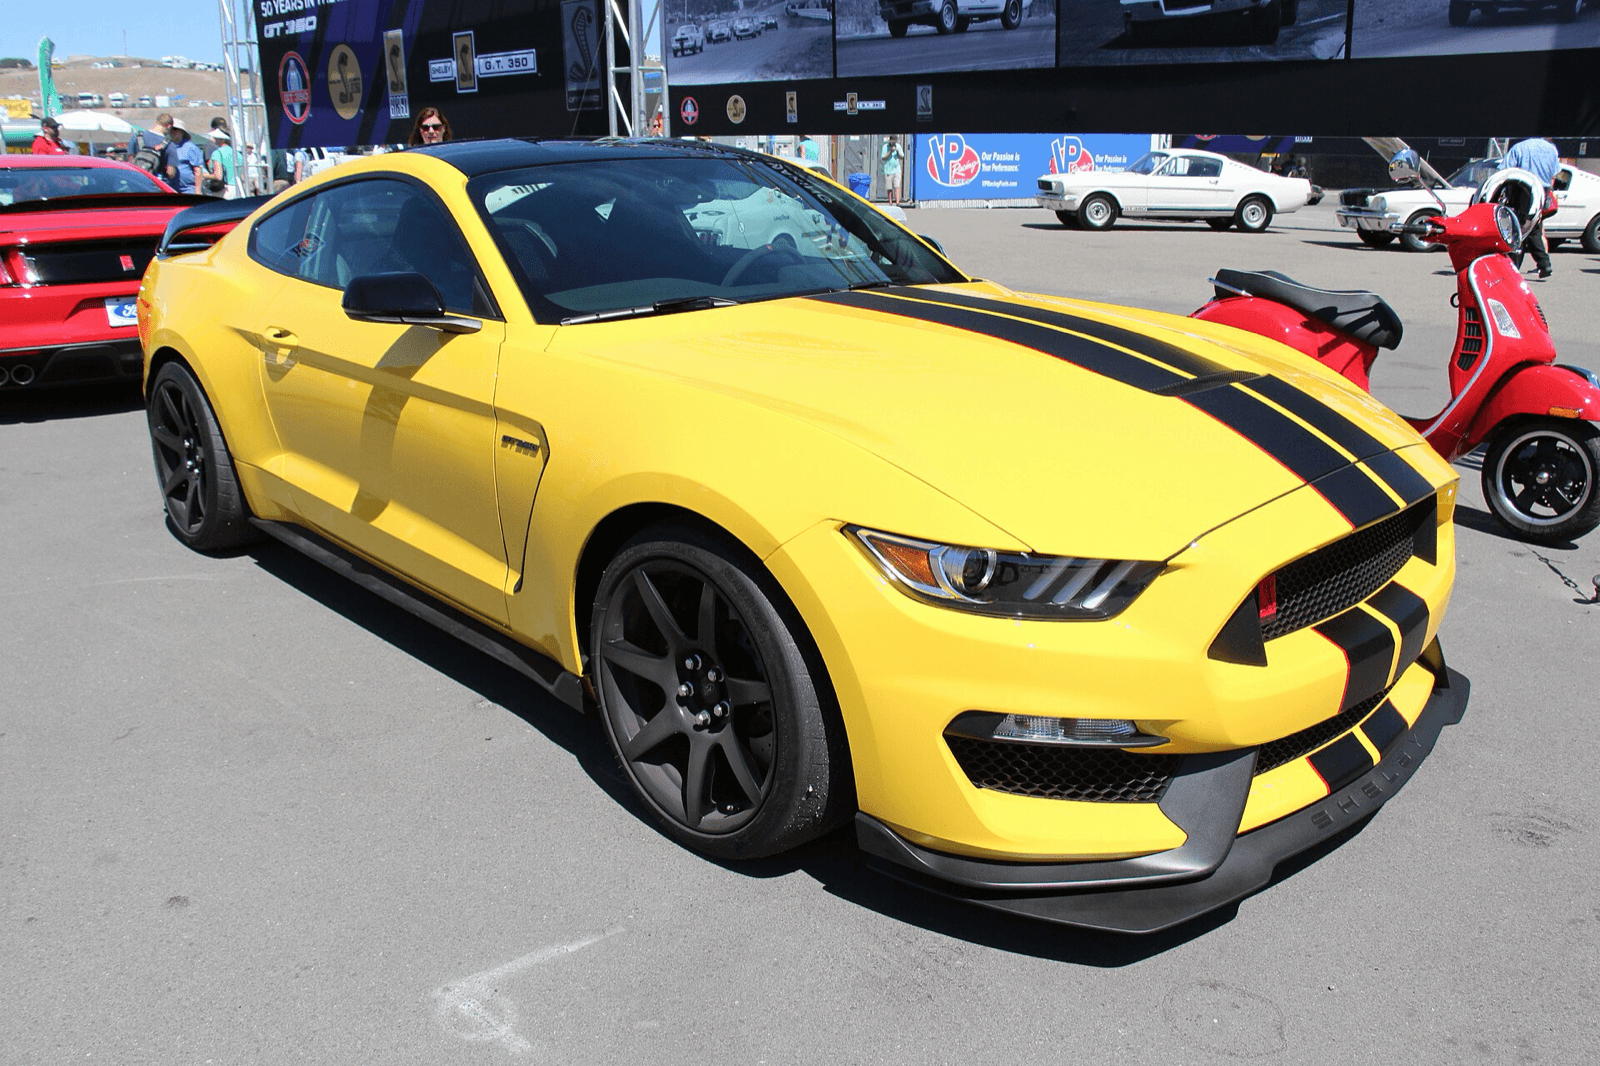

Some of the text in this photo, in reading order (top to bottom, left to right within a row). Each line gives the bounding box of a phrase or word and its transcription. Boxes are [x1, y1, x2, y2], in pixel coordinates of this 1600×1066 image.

[261, 1, 274, 17] 50
[273, 0, 304, 15] YEARS
[264, 15, 317, 38] GT 350
[431, 65, 451, 75] SHELBY
[484, 57, 529, 71] G.T. 350
[927, 133, 967, 187] VP
[981, 151, 1020, 162] Our Passion is
[1095, 154, 1105, 164] Our
[1104, 154, 1122, 164] Passion
[952, 159, 979, 179] Racing
[1310, 732, 1423, 832] SHELBY
